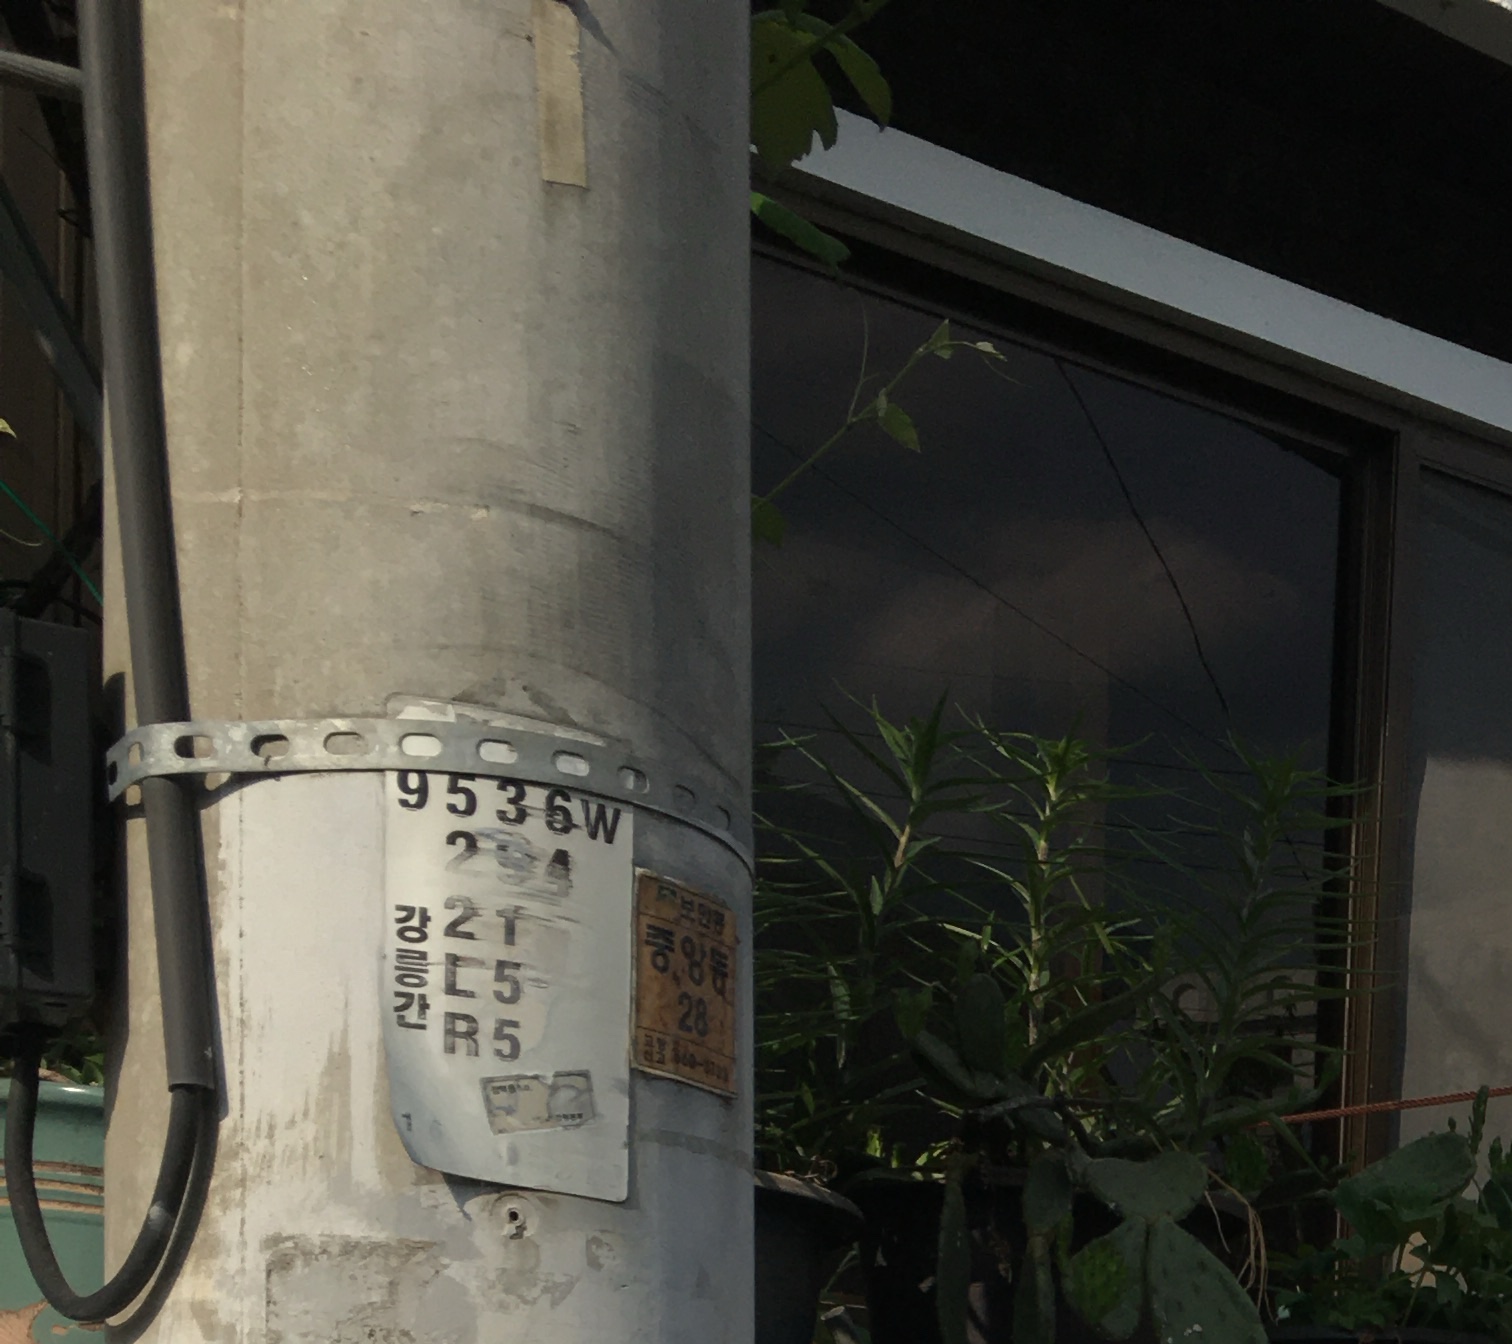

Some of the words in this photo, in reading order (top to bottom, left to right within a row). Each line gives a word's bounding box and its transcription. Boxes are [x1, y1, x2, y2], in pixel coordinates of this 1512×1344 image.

[396, 770, 621, 844] 9536W
[444, 952, 521, 1004] L5
[444, 1011, 521, 1062] R5
